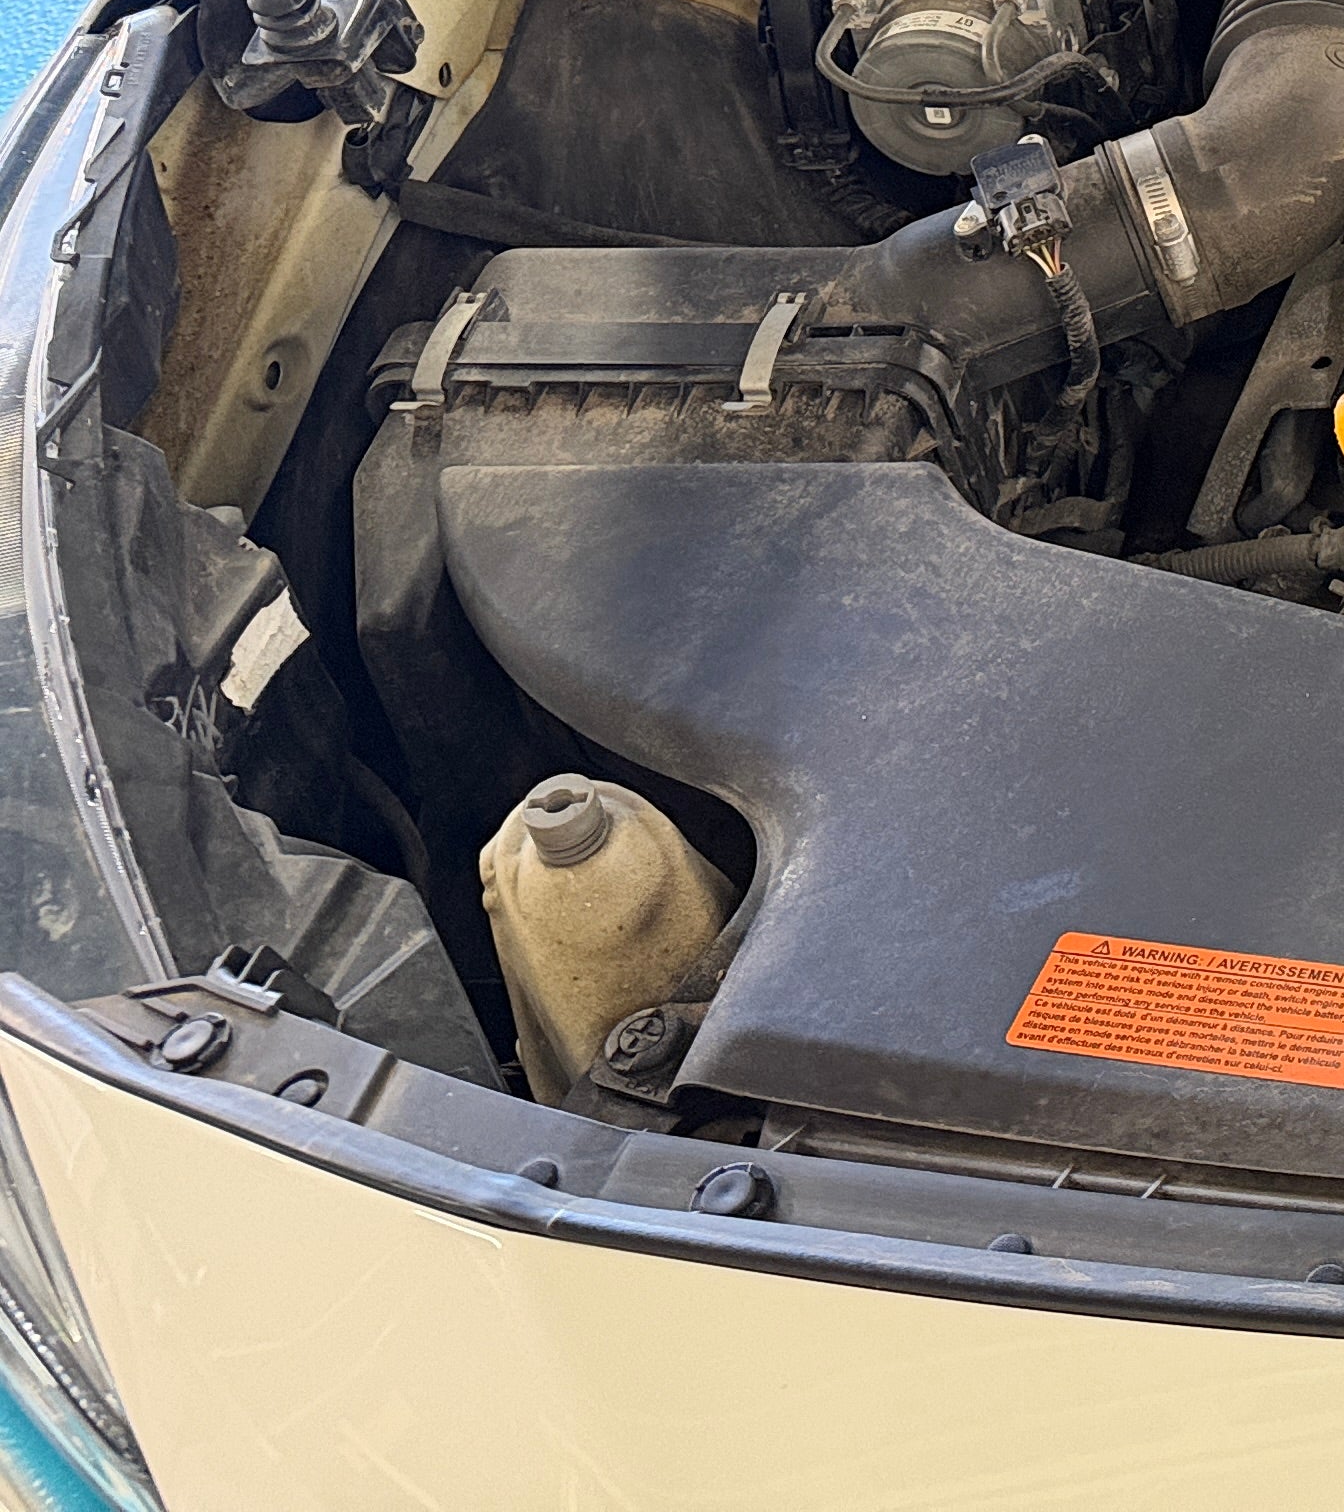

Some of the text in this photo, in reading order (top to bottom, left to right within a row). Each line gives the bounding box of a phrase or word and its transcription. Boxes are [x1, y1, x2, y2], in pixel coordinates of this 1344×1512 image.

[1046, 976, 1083, 987] system
[1084, 980, 1105, 991] into
[1106, 984, 1144, 996] service
[1146, 989, 1175, 999] mode
[1176, 993, 1197, 1002] and
[1198, 995, 1255, 1009] disconnect
[1256, 1002, 1273, 1012] the
[1275, 1006, 1312, 1017] vehicle
[1053, 964, 1065, 974] To
[1066, 967, 1102, 978] reduce
[1104, 972, 1120, 981] the
[1121, 974, 1141, 984] risk
[1143, 977, 1156, 986] of
[1156, 979, 1194, 991] serious
[1195, 983, 1226, 996] injury
[1227, 988, 1239, 996] or
[1274, 994, 1308, 1006] switch
[1310, 998, 1344, 1009] engine
[1059, 955, 1080, 965] This
[1082, 959, 1118, 969] vehicle
[1119, 963, 1129, 971] is
[1130, 965, 1178, 977] equipped
[1180, 971, 1201, 980] with
[1212, 976, 1248, 986] remote
[1249, 980, 1303, 993] controlled
[1303, 987, 1338, 997] engine
[1034, 998, 1049, 1008] Ce
[1051, 1001, 1093, 1014] véhicule
[1094, 1007, 1113, 1016] est
[1113, 1009, 1137, 1019] doté
[1165, 1016, 1220, 1030] démarreur
[1278, 1029, 1305, 1040] Pour
[1305, 1033, 1344, 1046] réduire
[1040, 986, 1074, 997] before
[1074, 991, 1132, 1007] performing
[1133, 998, 1153, 1009] any
[1154, 1001, 1191, 1013] service
[1193, 1007, 1207, 1015] on
[1209, 1008, 1226, 1017] the
[1016, 1031, 1047, 1042] avant
[1104, 1042, 1123, 1052] des
[1125, 1045, 1165, 1058] travaux
[1223, 1058, 1241, 1068] sur
[1022, 1019, 1342, 1070] distance en mode service et débrancher la batterie du véhicule
[1027, 1009, 1067, 1022] risques
[1068, 1014, 1082, 1024] de
[1083, 1016, 1134, 1029] blessures
[1134, 1025, 1171, 1036] graves
[1172, 1029, 1187, 1037] ou
[1241, 1037, 1276, 1049] mettre
[1277, 1041, 1288, 1050] le
[1288, 1043, 1344, 1058] démarreur
